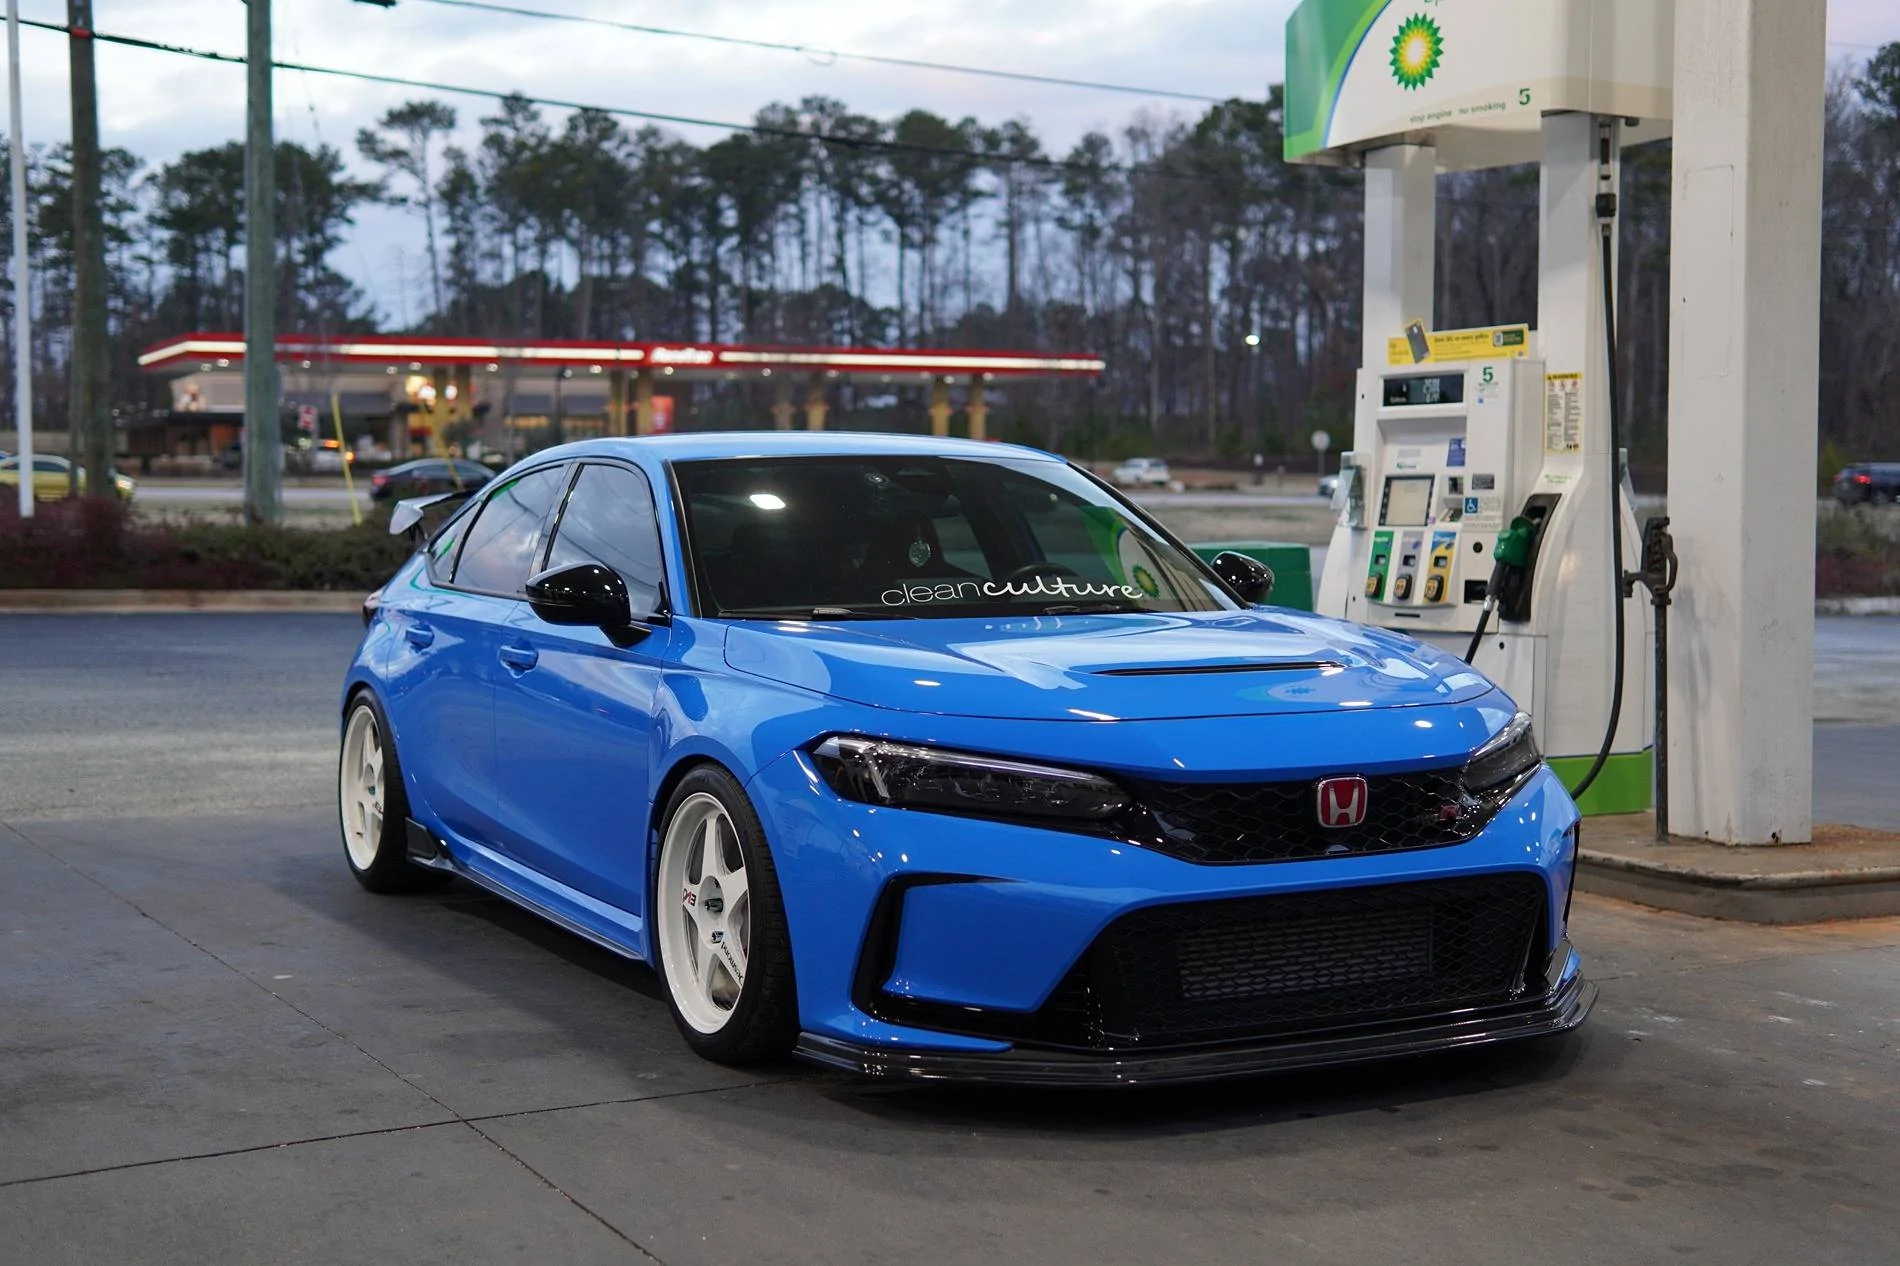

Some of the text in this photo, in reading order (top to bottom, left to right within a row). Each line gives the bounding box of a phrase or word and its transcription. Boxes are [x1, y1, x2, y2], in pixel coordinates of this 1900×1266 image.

[1519, 88, 1531, 106] 5
[1427, 110, 1452, 121] engine
[1458, 107, 1469, 115] no
[1471, 102, 1506, 113] smoking
[1482, 366, 1494, 383] 5
